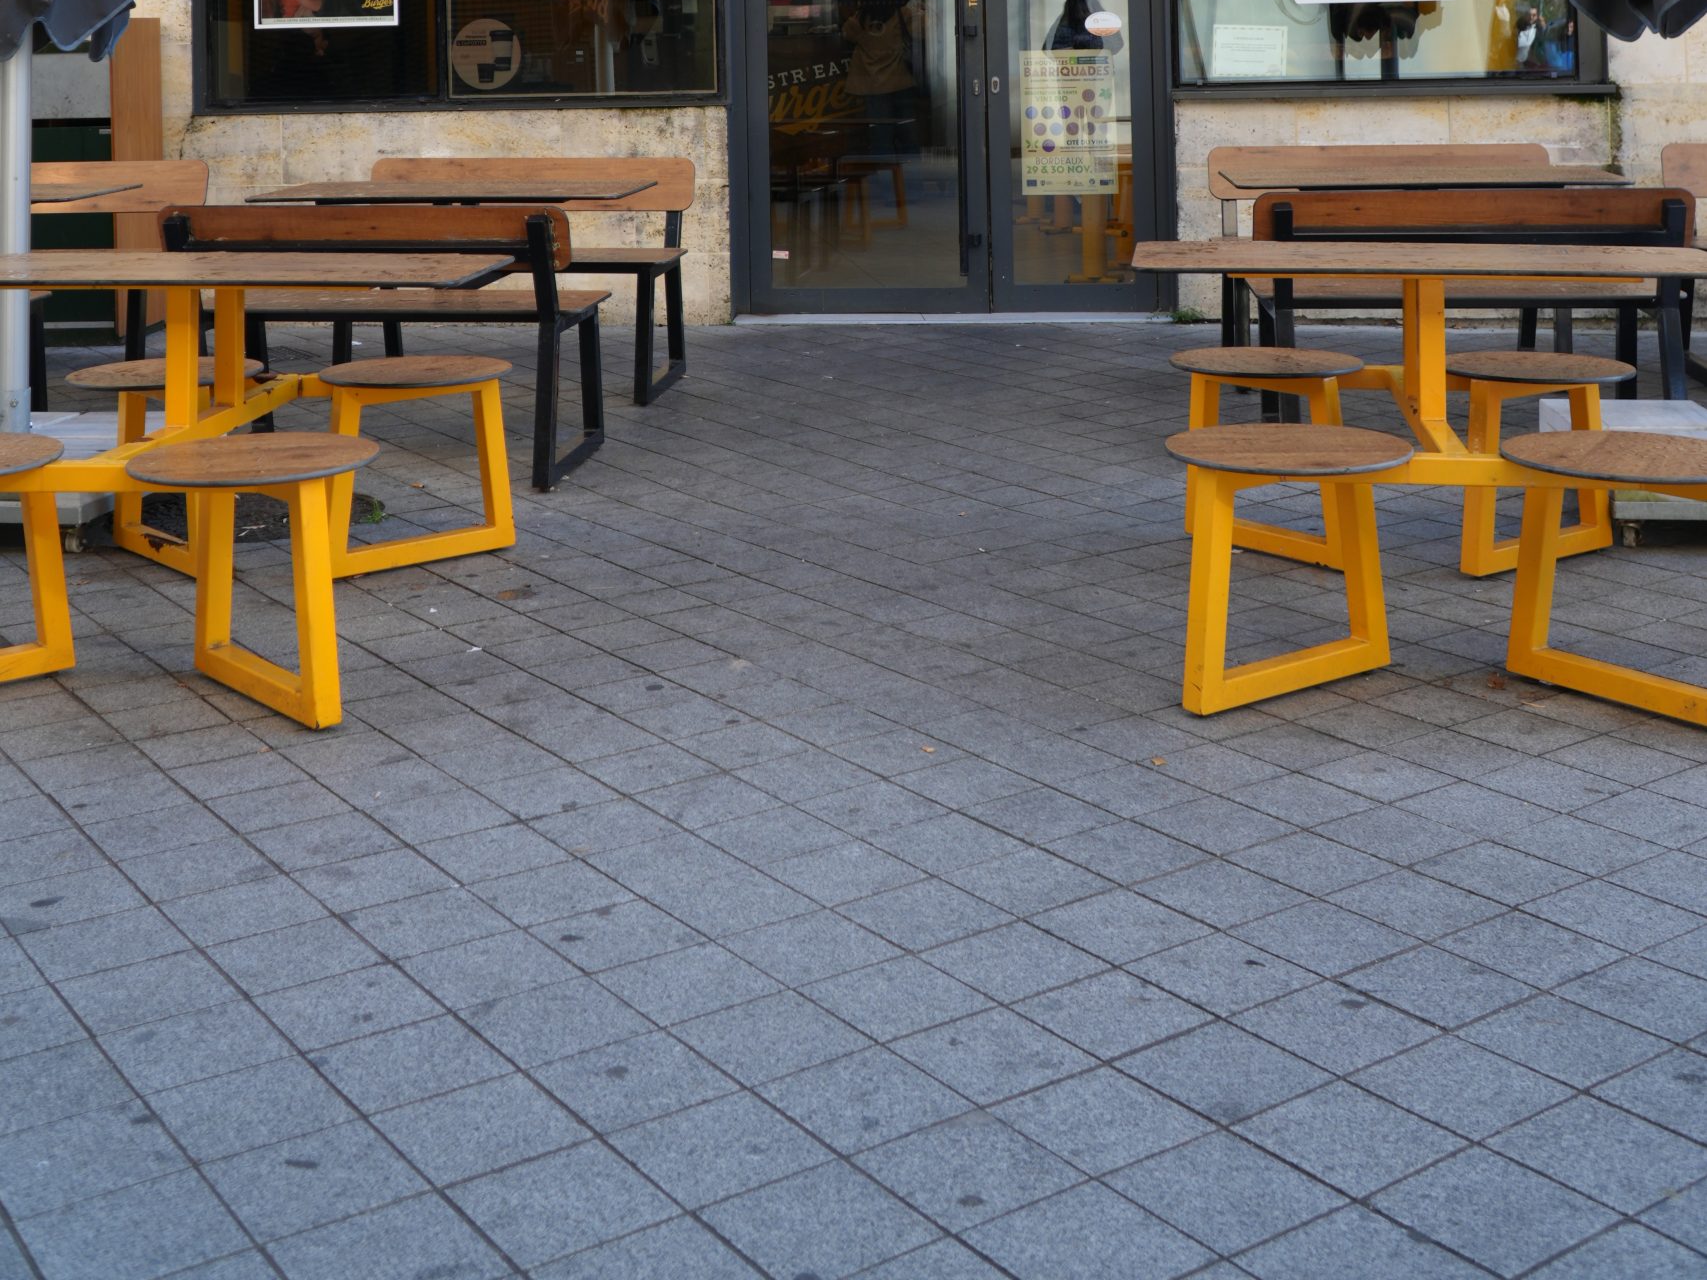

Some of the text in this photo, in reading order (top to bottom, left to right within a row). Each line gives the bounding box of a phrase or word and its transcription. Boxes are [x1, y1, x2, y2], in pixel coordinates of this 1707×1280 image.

[1024, 65, 1110, 77] BARRIQUADES
[1035, 157, 1084, 166] BORDEAUX
[1026, 165, 1092, 174] 29 & 30 NOV.
